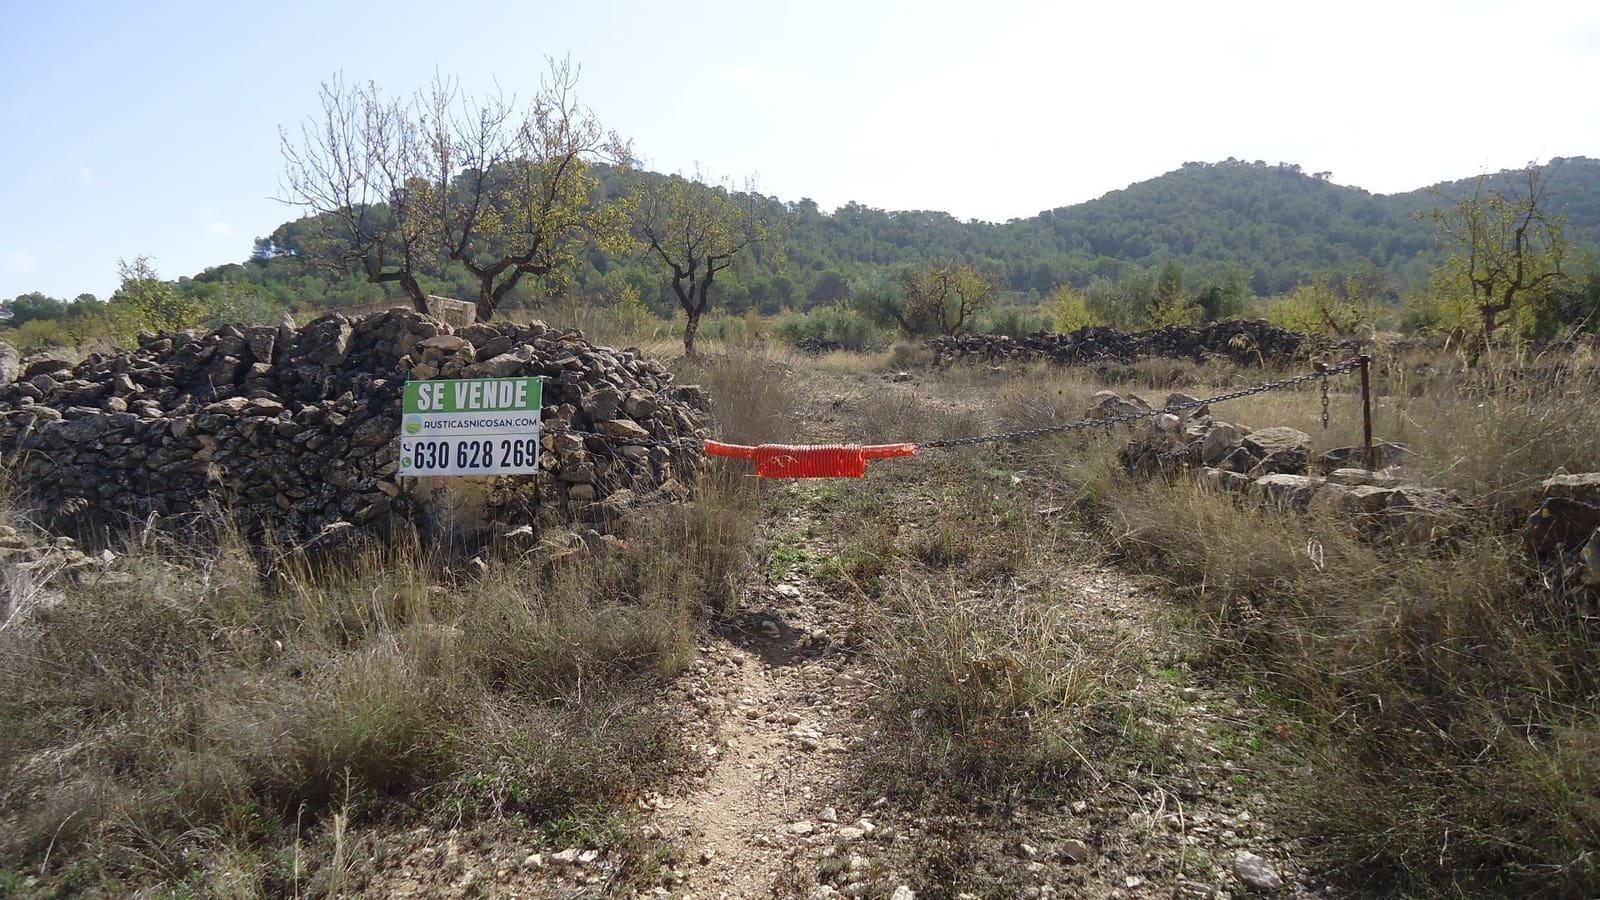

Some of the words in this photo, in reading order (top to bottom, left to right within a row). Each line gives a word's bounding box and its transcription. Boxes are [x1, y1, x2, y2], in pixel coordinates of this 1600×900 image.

[417, 383, 445, 411] SE
[454, 380, 528, 409] VENDE
[424, 418, 537, 429] RUSTICASNICOSAN.COM
[414, 441, 449, 469] 630
[457, 440, 493, 468] 628
[501, 439, 536, 467] 269
